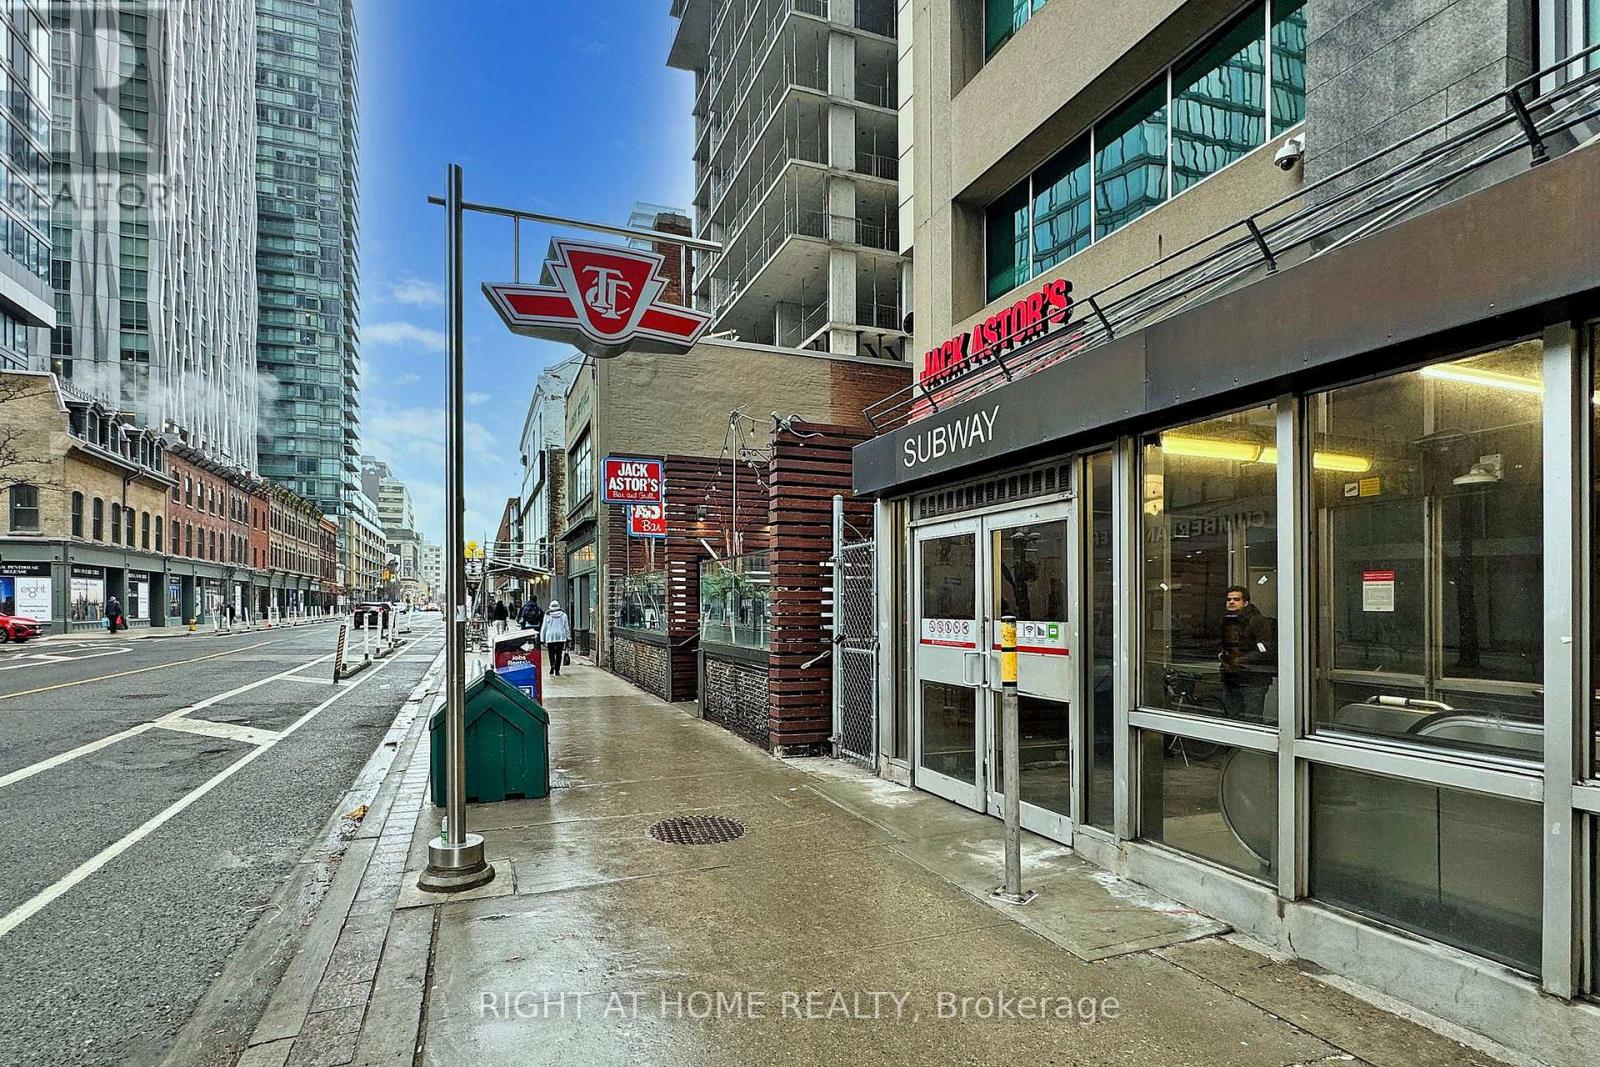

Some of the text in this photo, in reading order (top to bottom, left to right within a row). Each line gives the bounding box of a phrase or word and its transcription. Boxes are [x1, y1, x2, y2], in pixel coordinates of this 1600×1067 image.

[920, 278, 1070, 387] JACK ASTOR'S
[903, 405, 1000, 468] SUBWAY
[617, 462, 649, 478] JACK
[608, 476, 659, 493] ASTOR'S
[638, 492, 656, 500] Grill
[641, 519, 663, 532] Bar
[20, 580, 46, 598] eight
